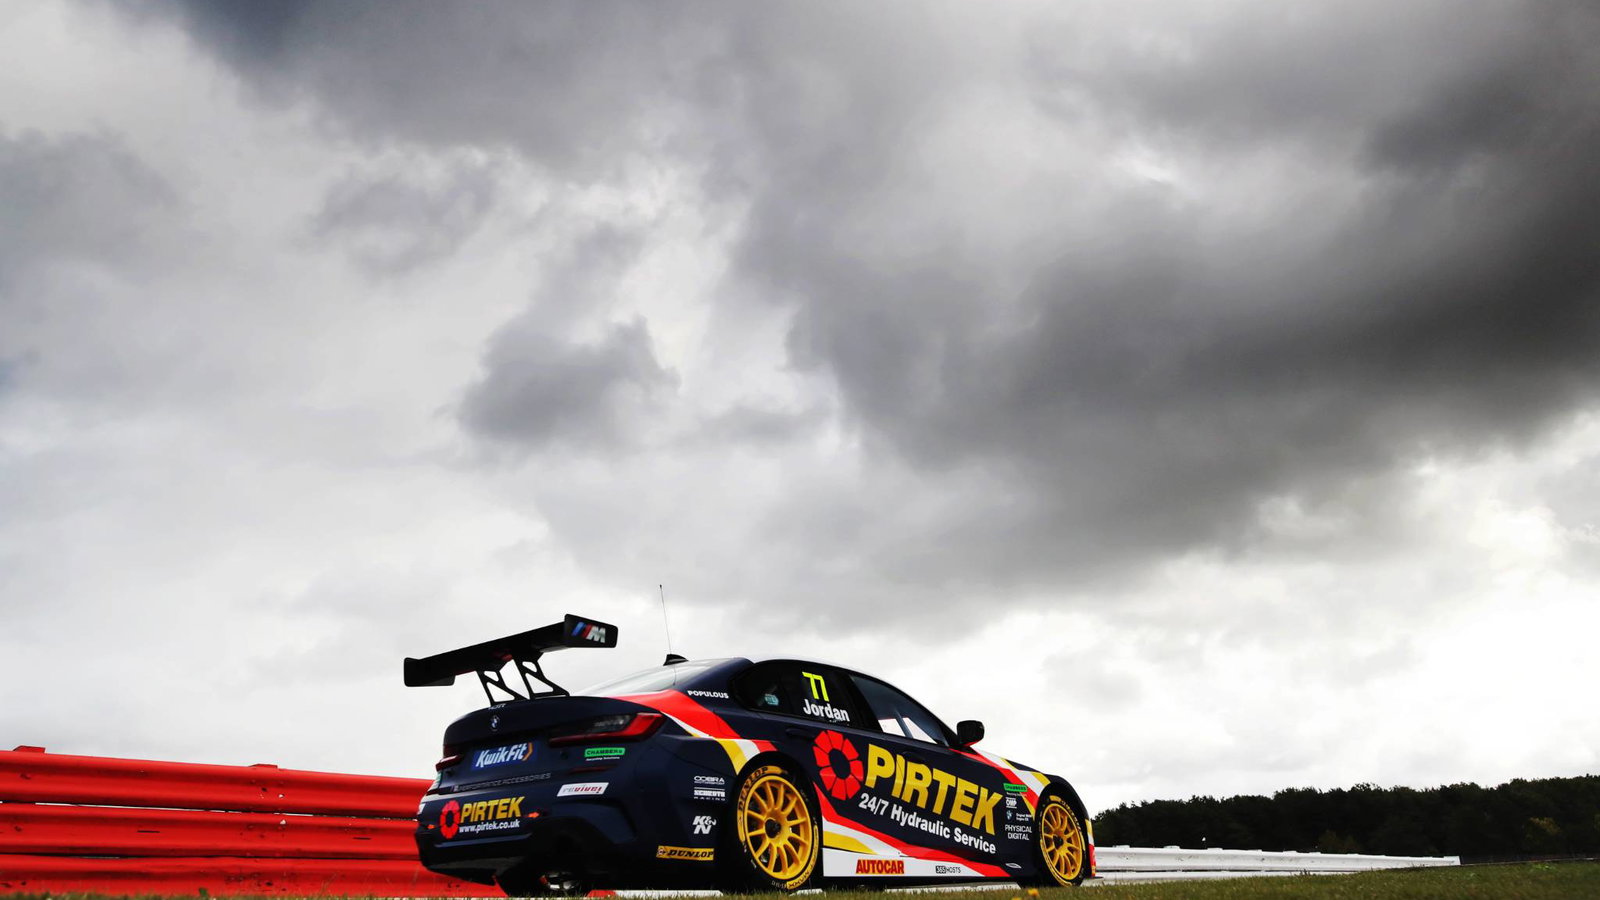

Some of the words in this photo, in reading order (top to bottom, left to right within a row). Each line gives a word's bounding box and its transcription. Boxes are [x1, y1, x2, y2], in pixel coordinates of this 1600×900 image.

[802, 671, 830, 702] 77
[687, 690, 729, 699] POPULOUS
[803, 699, 850, 722] Jordan
[693, 775, 725, 783] COBRA
[865, 743, 1003, 836] PIRTEK
[460, 796, 525, 823] PIRTEK
[459, 819, 520, 834] www.pirtek.co.uk
[858, 792, 889, 816] 24/7
[890, 804, 951, 839] Hydraulic
[953, 827, 996, 854] Service
[1005, 824, 1032, 833] PHYSICAL
[1007, 832, 1029, 840] DIGITAL
[667, 849, 714, 858] DUNLOP
[855, 859, 905, 874] AUTOCAR
